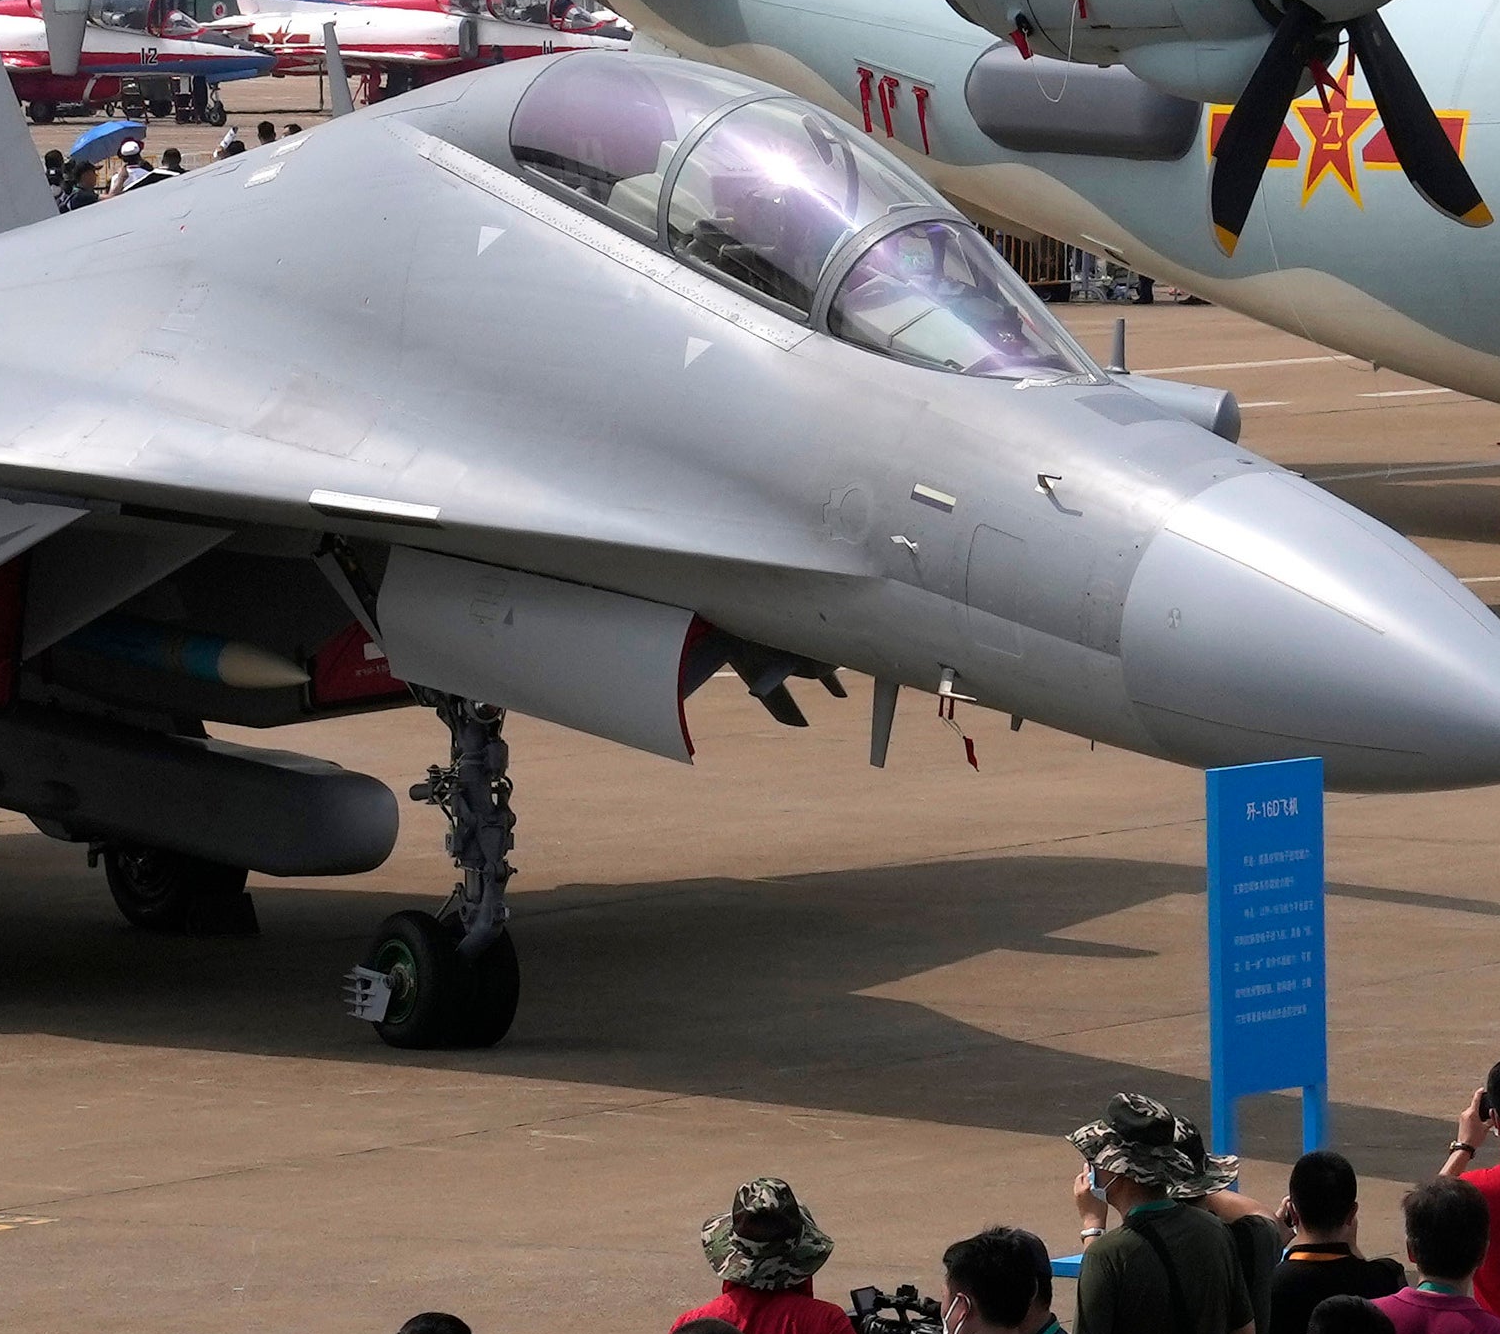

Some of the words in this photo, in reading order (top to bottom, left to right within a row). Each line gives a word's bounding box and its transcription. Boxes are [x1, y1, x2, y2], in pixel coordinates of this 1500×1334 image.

[140, 47, 159, 65] 12
[1246, 796, 1298, 821] 歼-16D飞机
